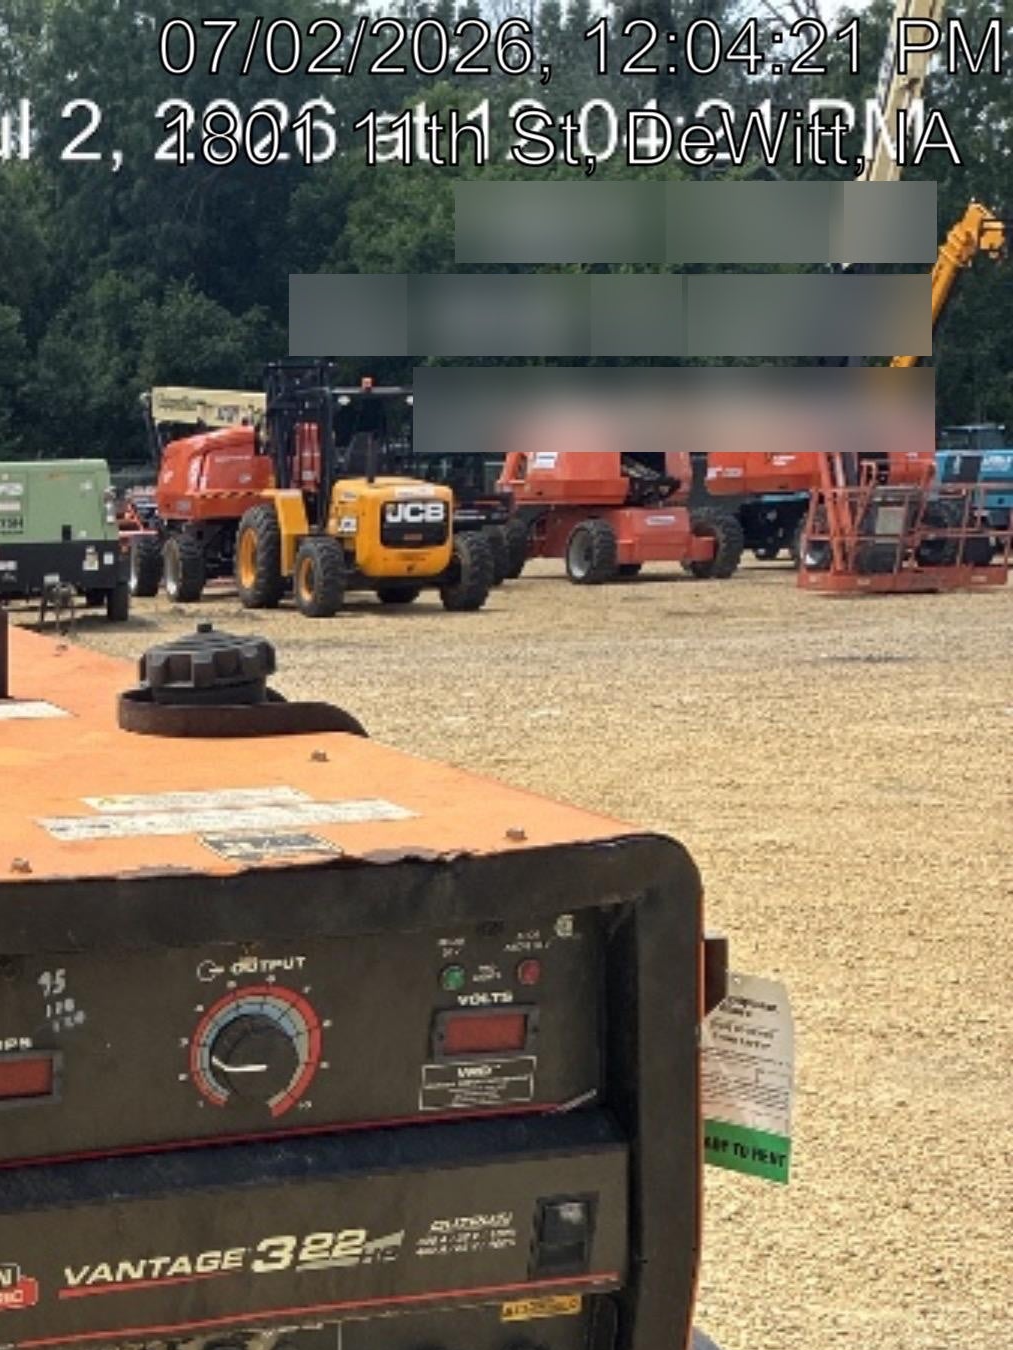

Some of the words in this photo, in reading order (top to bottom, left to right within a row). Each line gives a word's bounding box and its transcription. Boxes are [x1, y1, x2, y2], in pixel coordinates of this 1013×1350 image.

[386, 503, 445, 522] JCB
[230, 956, 307, 976] OUTPUT
[64, 1247, 246, 1286] VANTAGE
[251, 1229, 367, 1273] 322
